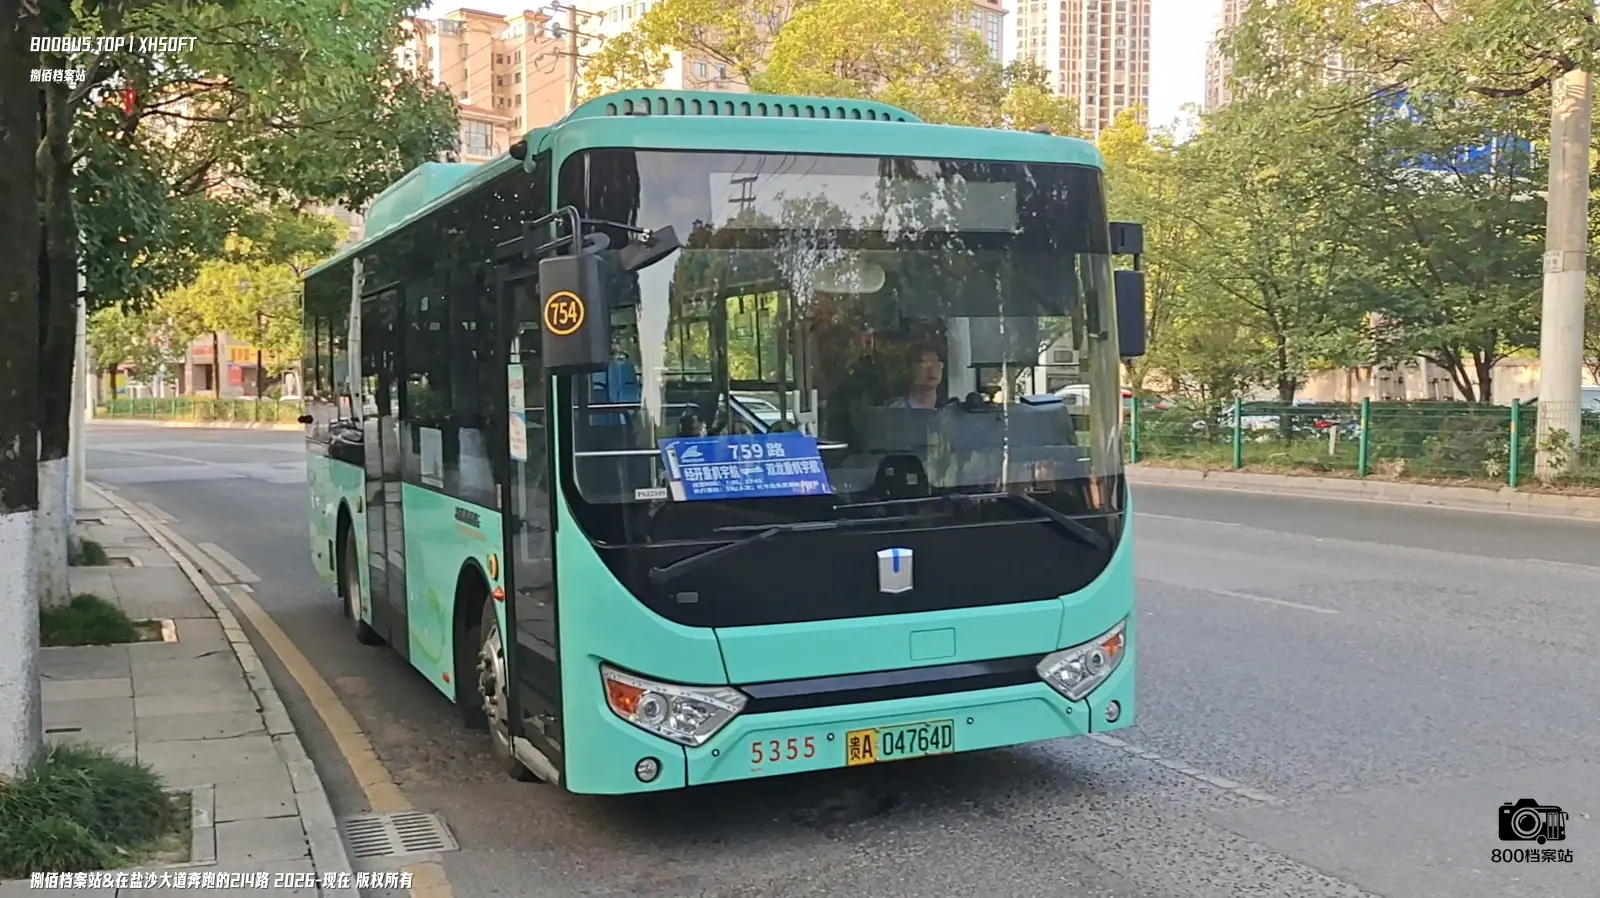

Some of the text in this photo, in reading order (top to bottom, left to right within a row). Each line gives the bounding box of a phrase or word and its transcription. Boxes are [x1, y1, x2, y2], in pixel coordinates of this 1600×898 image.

[550, 301, 577, 325] 754
[728, 443, 785, 459] 759 路
[751, 737, 816, 764] 5355
[849, 725, 953, 761] 贵A 04764D
